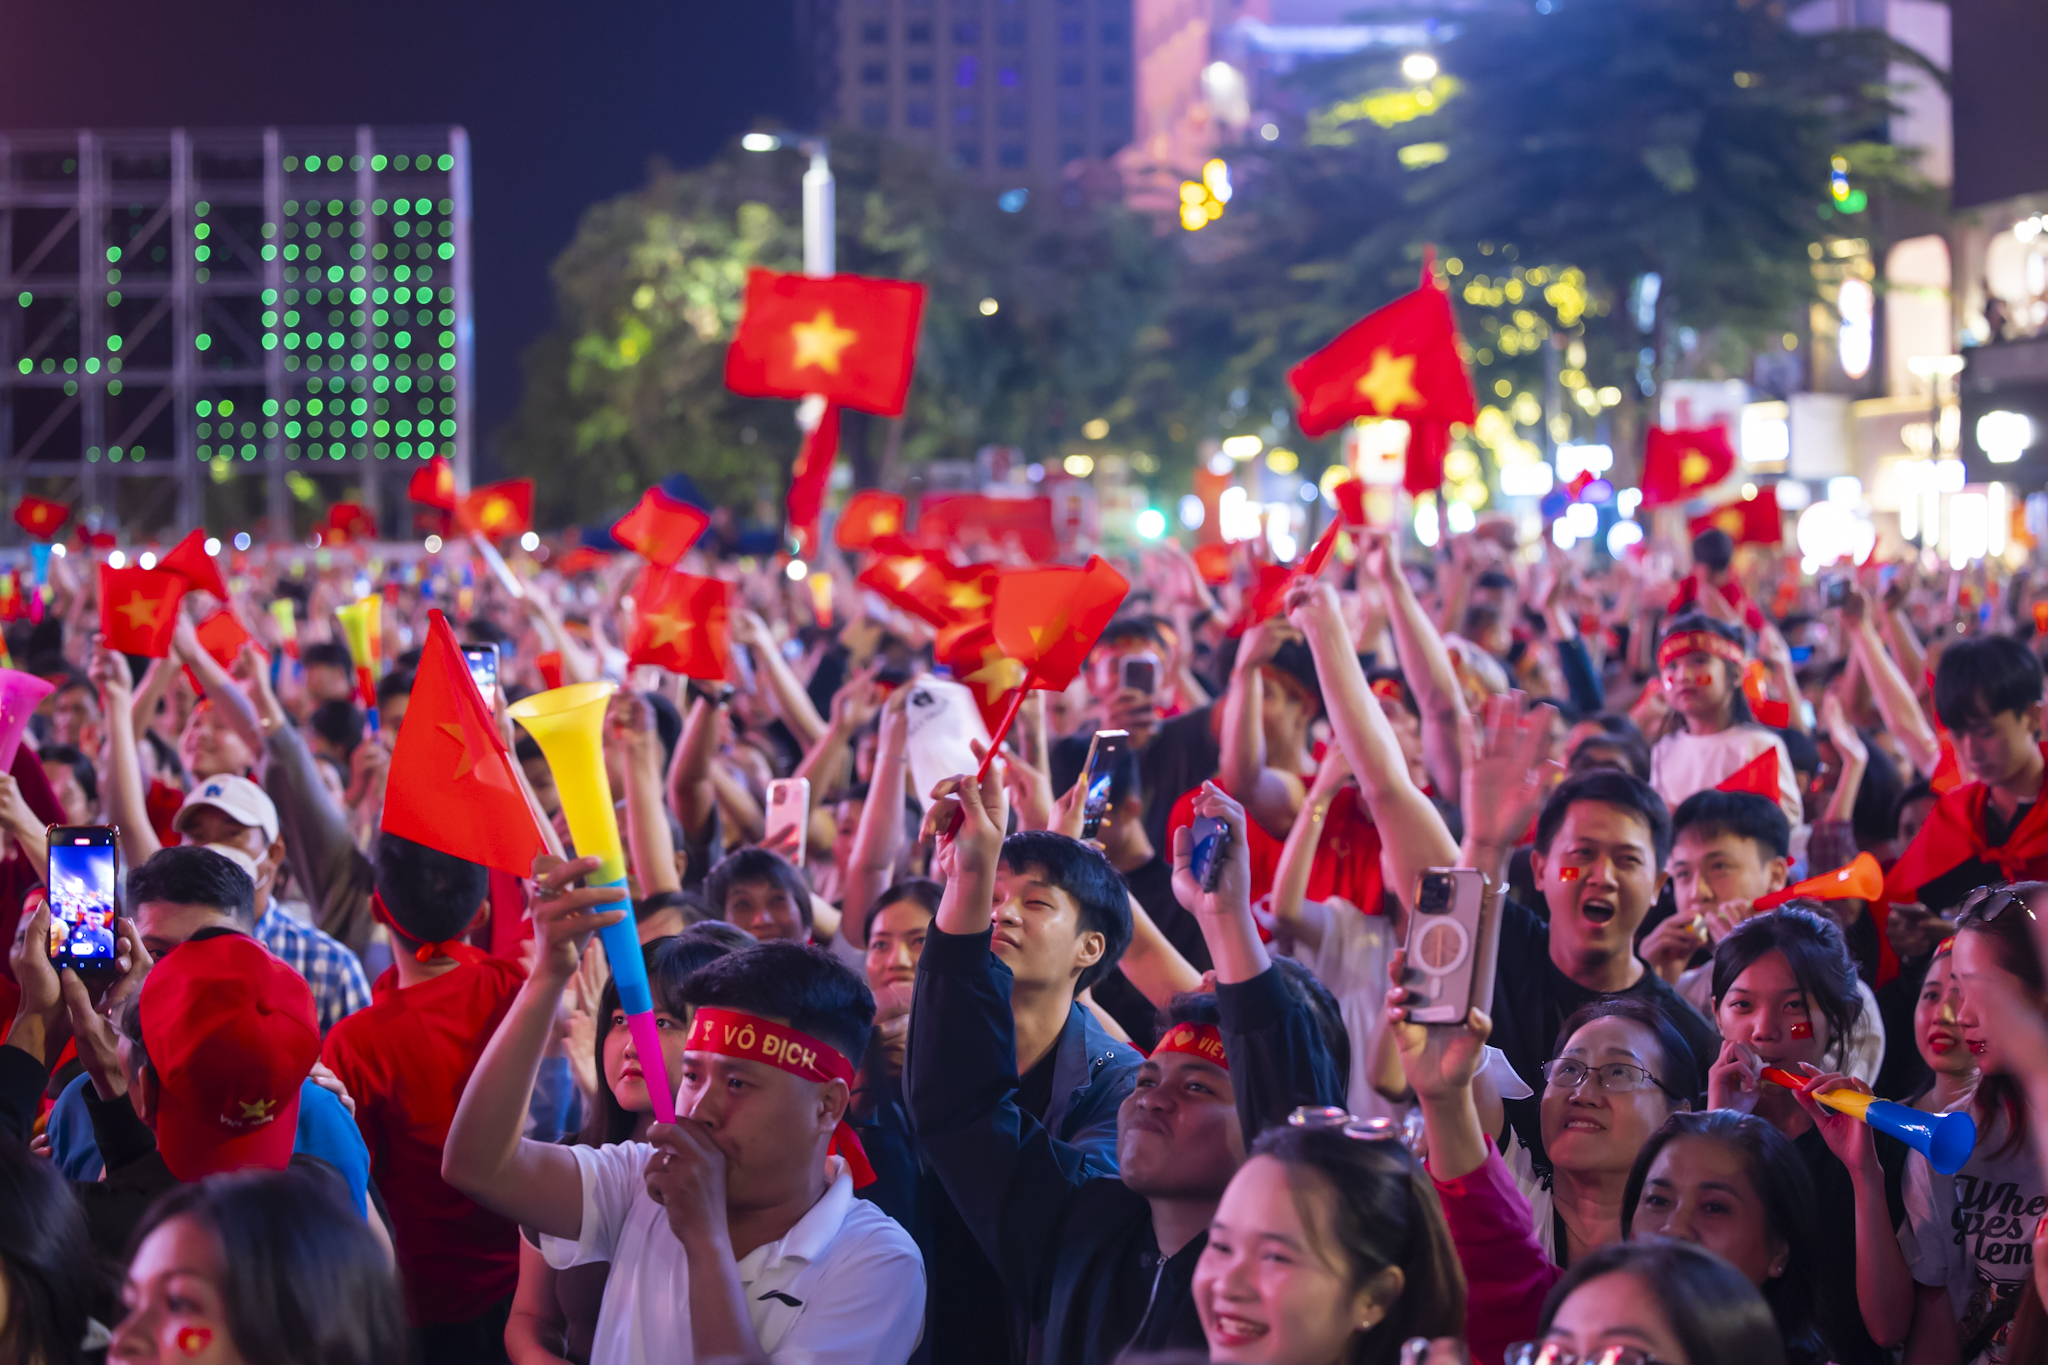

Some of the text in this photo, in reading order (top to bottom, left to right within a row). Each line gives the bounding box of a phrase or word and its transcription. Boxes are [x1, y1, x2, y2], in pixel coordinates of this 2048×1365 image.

[724, 1023, 756, 1050] VÔ
[762, 1034, 817, 1070] ĐỊCH
[1954, 1174, 2048, 1217] Whe
[1974, 1229, 2035, 1265] lem
